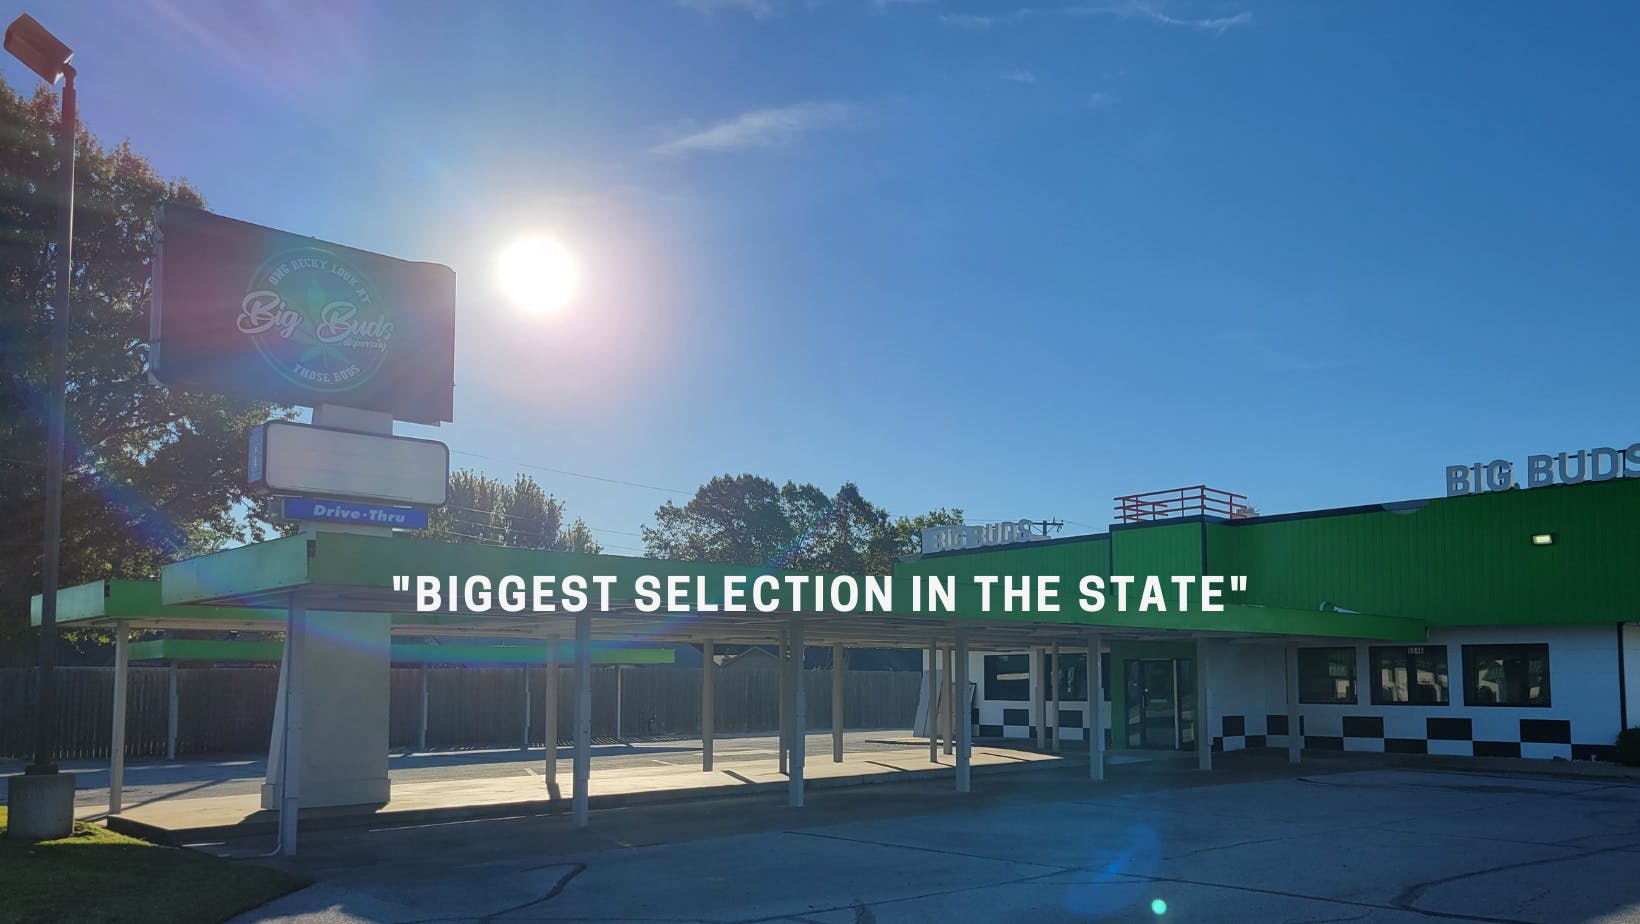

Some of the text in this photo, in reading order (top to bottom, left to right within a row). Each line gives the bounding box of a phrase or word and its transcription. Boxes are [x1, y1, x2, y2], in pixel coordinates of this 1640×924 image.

[291, 257, 329, 271] BECKY
[331, 264, 360, 287] LOOK
[236, 290, 395, 344] Big Buds
[294, 363, 361, 383] THOSE BUDS
[972, 519, 1033, 548] BUDS
